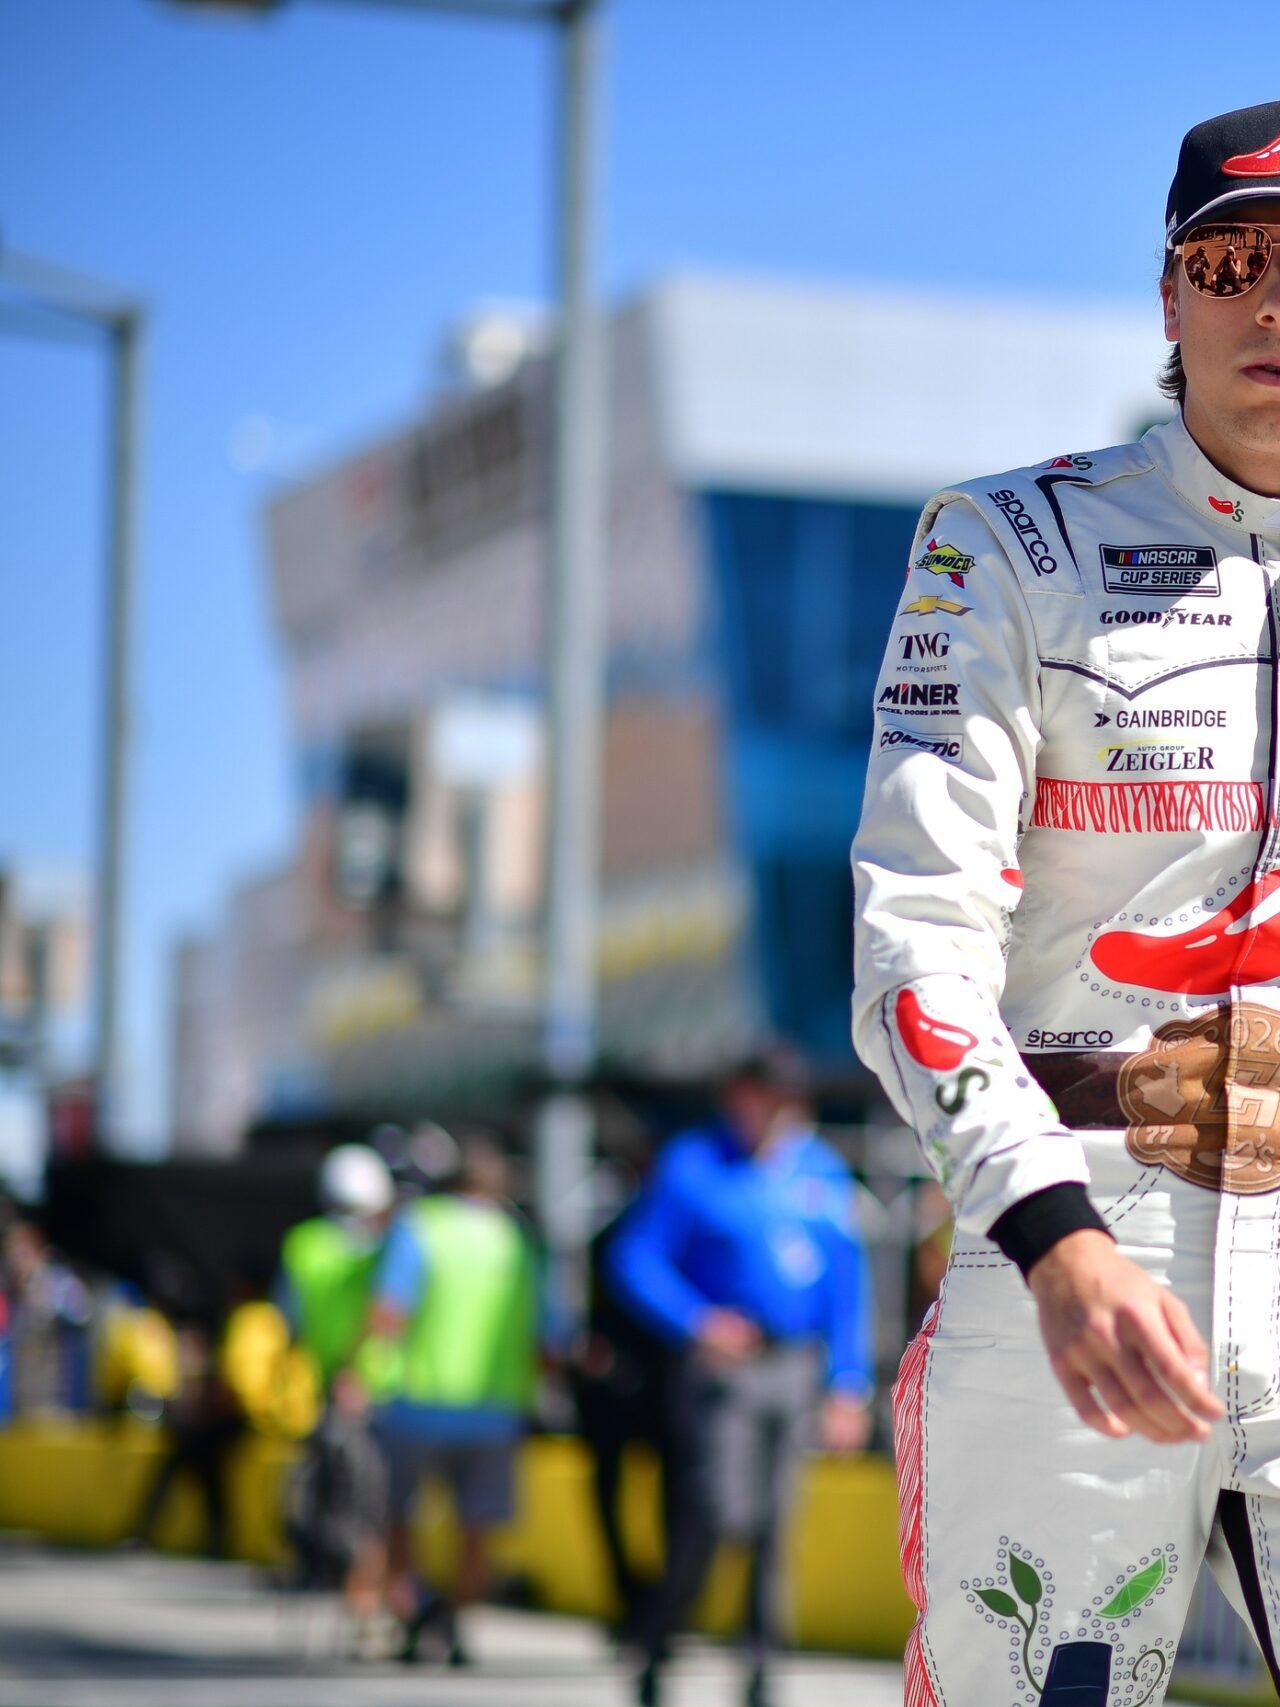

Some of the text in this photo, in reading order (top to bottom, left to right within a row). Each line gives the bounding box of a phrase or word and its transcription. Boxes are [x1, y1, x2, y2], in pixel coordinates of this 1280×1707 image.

[989, 489, 1058, 576] sparco
[918, 554, 970, 571] SUNOCO
[1138, 551, 1198, 564] NASCAR
[1120, 571, 1202, 584] CUP SERIES
[899, 632, 950, 659] TWG
[896, 665, 948, 673] MOTORSPORTS
[879, 683, 960, 706] MINER
[1116, 710, 1227, 728] GAINBRIDGE
[881, 730, 960, 757] COMETIC
[1107, 747, 1215, 772] ZEIGLER
[1026, 1029, 1113, 1049] sparco
[1146, 1125, 1175, 1144] 77
